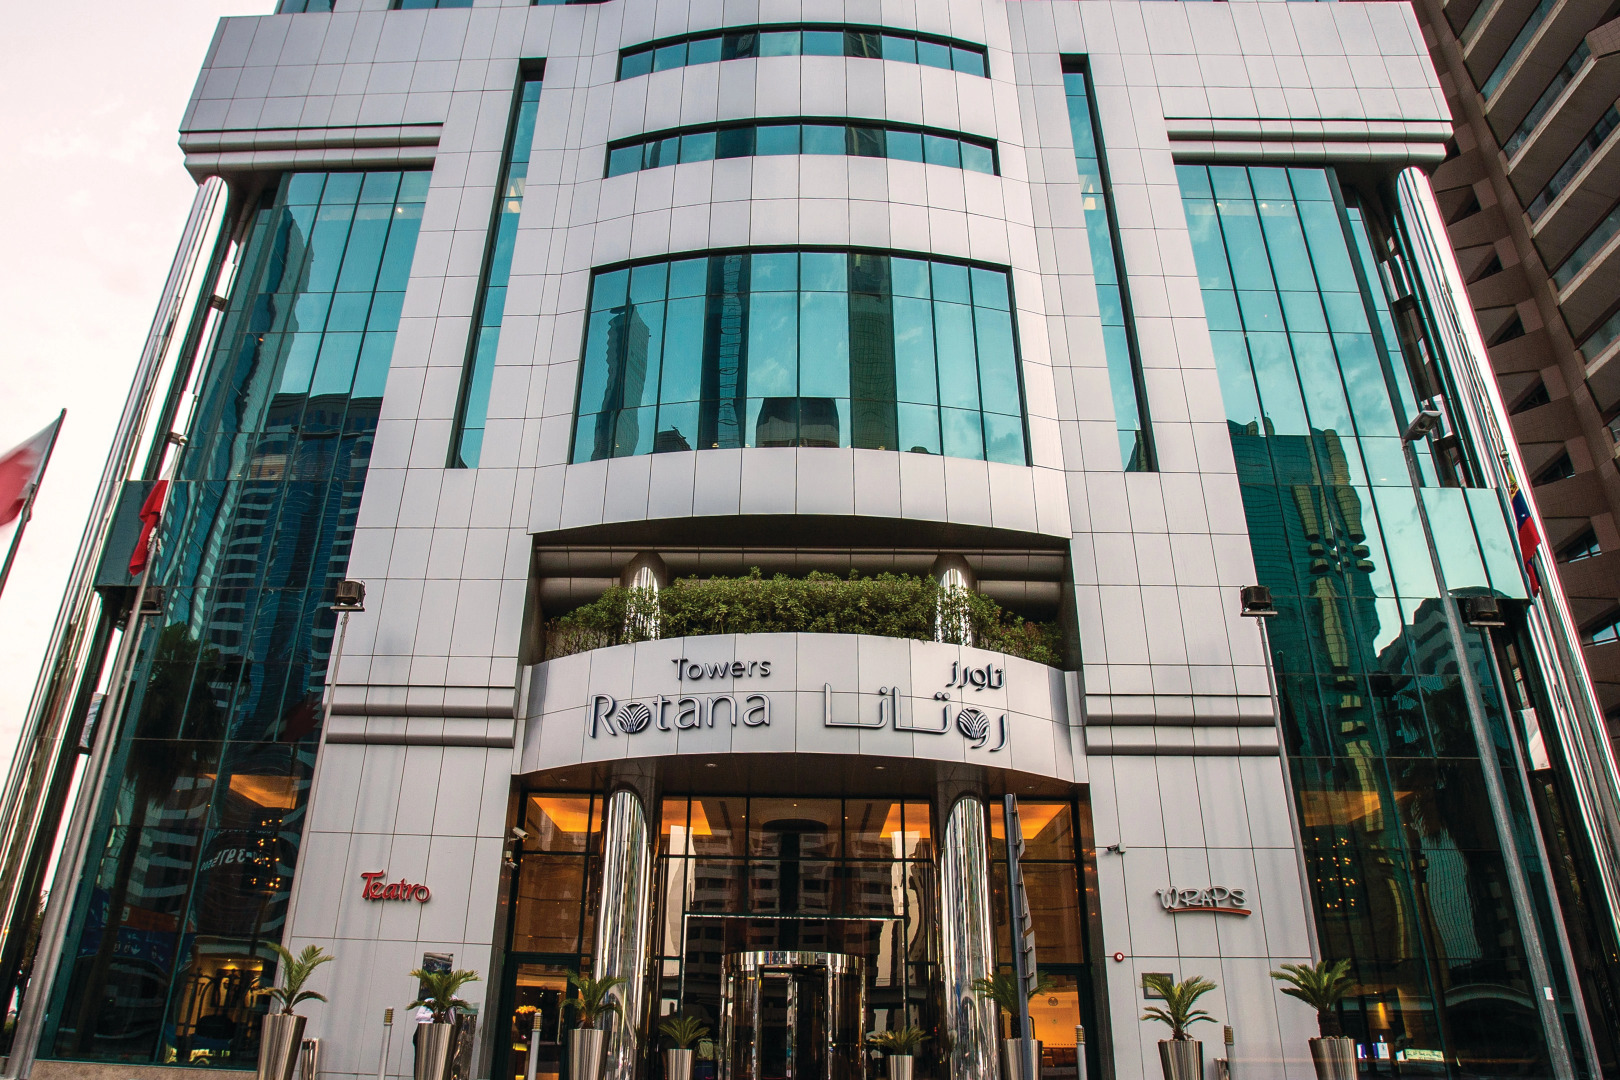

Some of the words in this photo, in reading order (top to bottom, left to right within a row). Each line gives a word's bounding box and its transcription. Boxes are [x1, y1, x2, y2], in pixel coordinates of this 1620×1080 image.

[671, 658, 771, 680] Towers
[945, 660, 1005, 692] تاورز
[588, 693, 771, 739] Rotana
[824, 682, 1010, 752] روتانا
[360, 869, 430, 903] Teatro
[1156, 886, 1248, 909] WRAPS
